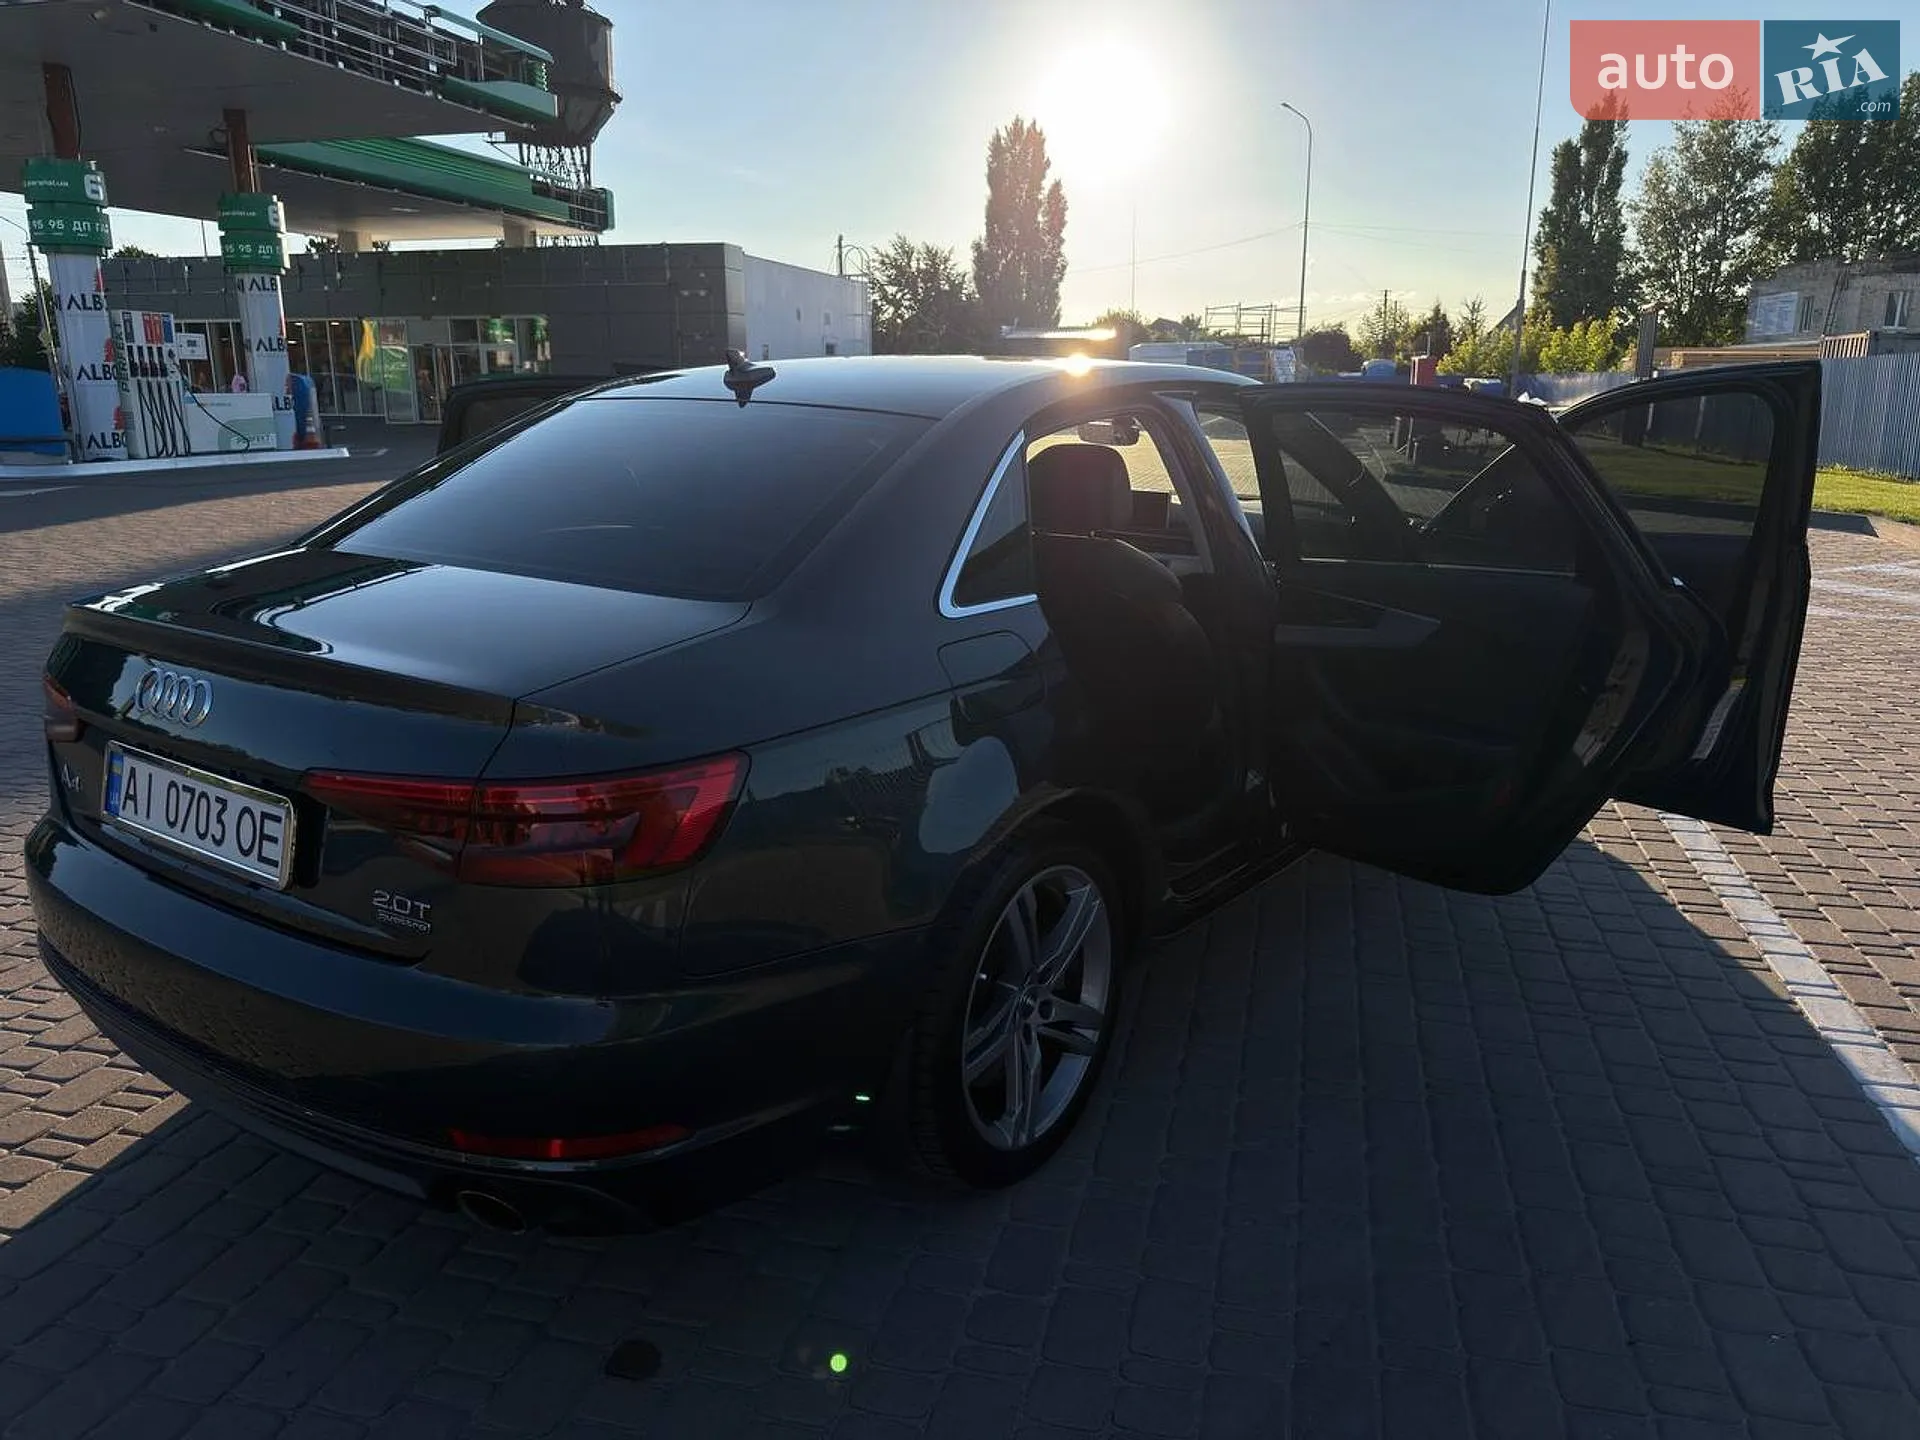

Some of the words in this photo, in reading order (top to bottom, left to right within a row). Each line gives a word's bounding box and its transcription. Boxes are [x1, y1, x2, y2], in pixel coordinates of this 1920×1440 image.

[122, 766, 153, 820] AI
[165, 780, 228, 847] 0703
[236, 806, 282, 868] OE
